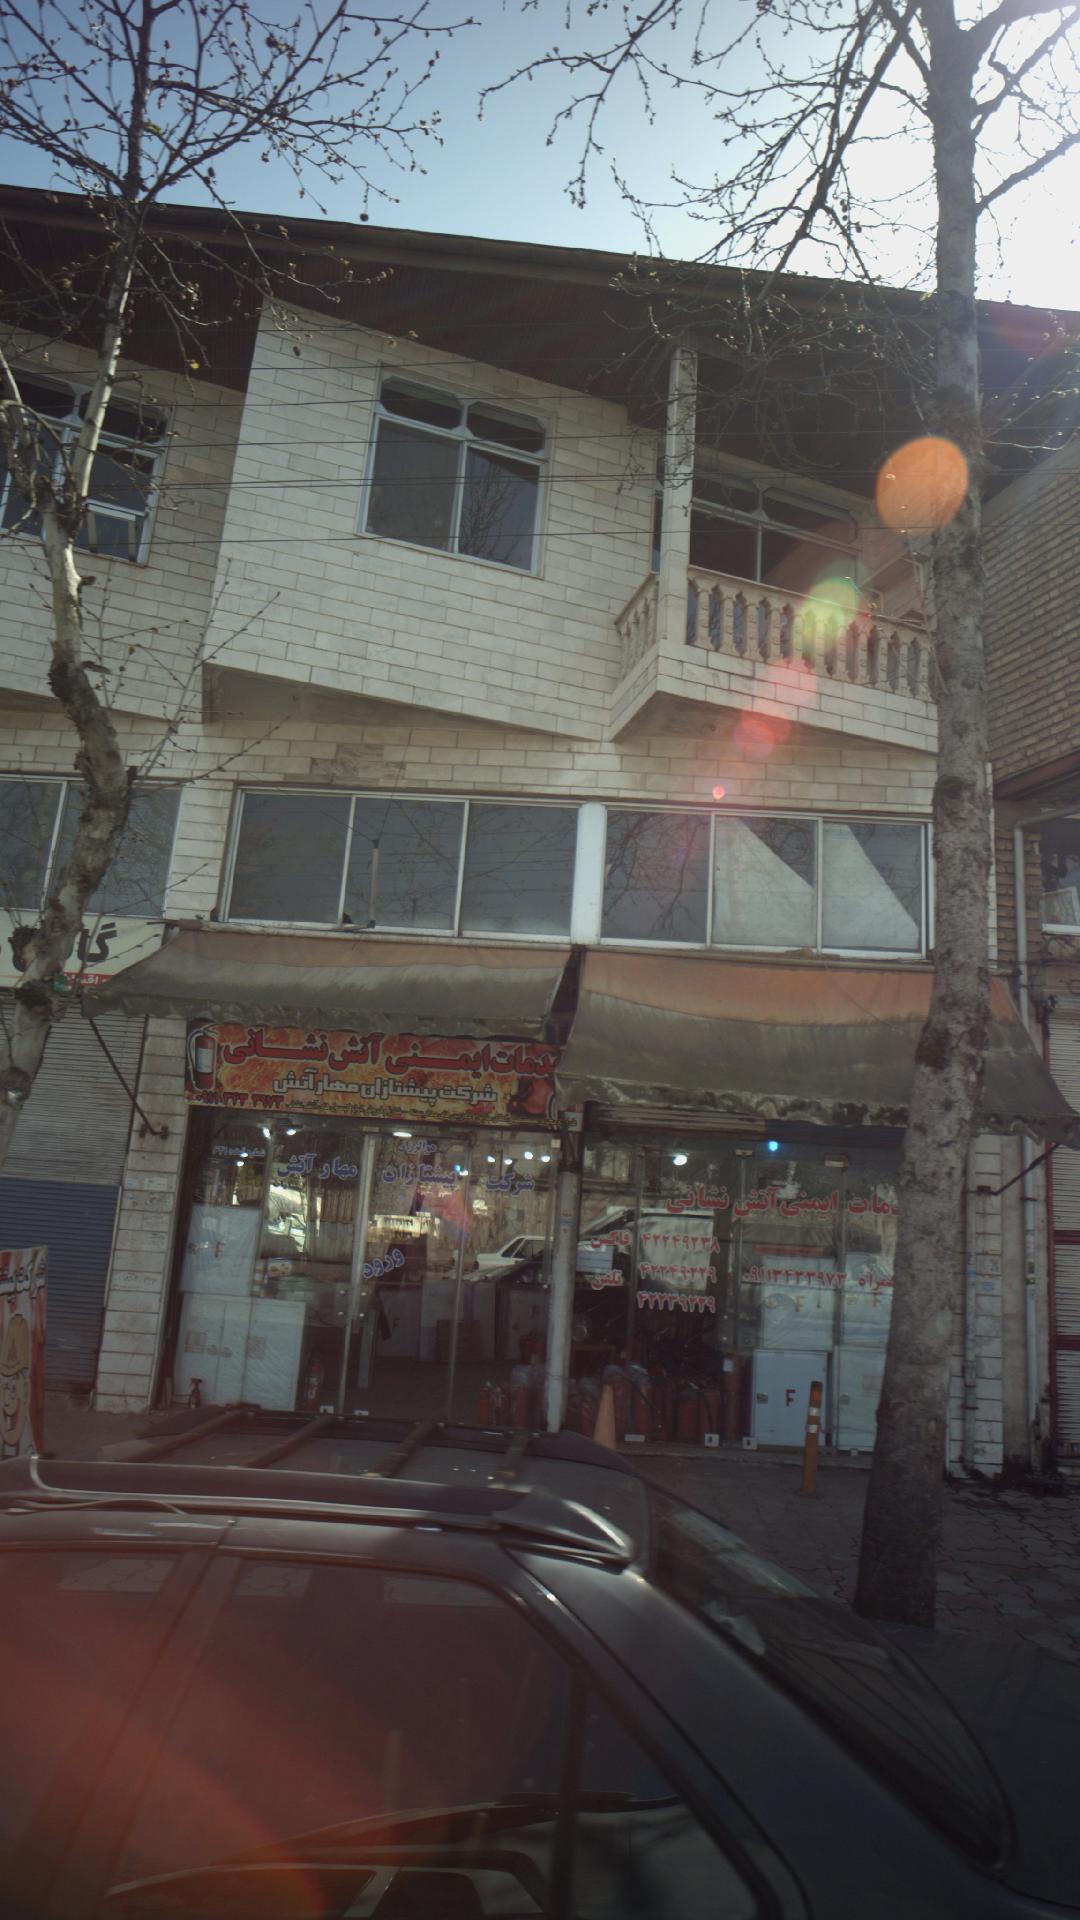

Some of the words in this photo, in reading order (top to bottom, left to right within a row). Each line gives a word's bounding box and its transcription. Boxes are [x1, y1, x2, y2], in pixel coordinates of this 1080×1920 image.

[223, 1028, 330, 1064] نشانی
[328, 1031, 385, 1071] آتش
[385, 1042, 491, 1079] ایمنی
[272, 1067, 318, 1094] آتش
[315, 1073, 360, 1095] مهار
[360, 1076, 438, 1106] پیشتازان
[439, 1083, 498, 1105] شرکت
[276, 1152, 317, 1178] آتش
[485, 1172, 535, 1196] شرکت
[666, 1185, 730, 1213] نشانی
[733, 1187, 778, 1217] آتش
[780, 1190, 839, 1220] ایمنی
[363, 1248, 405, 1279] ورود
[785, 1389, 796, 1407] F
